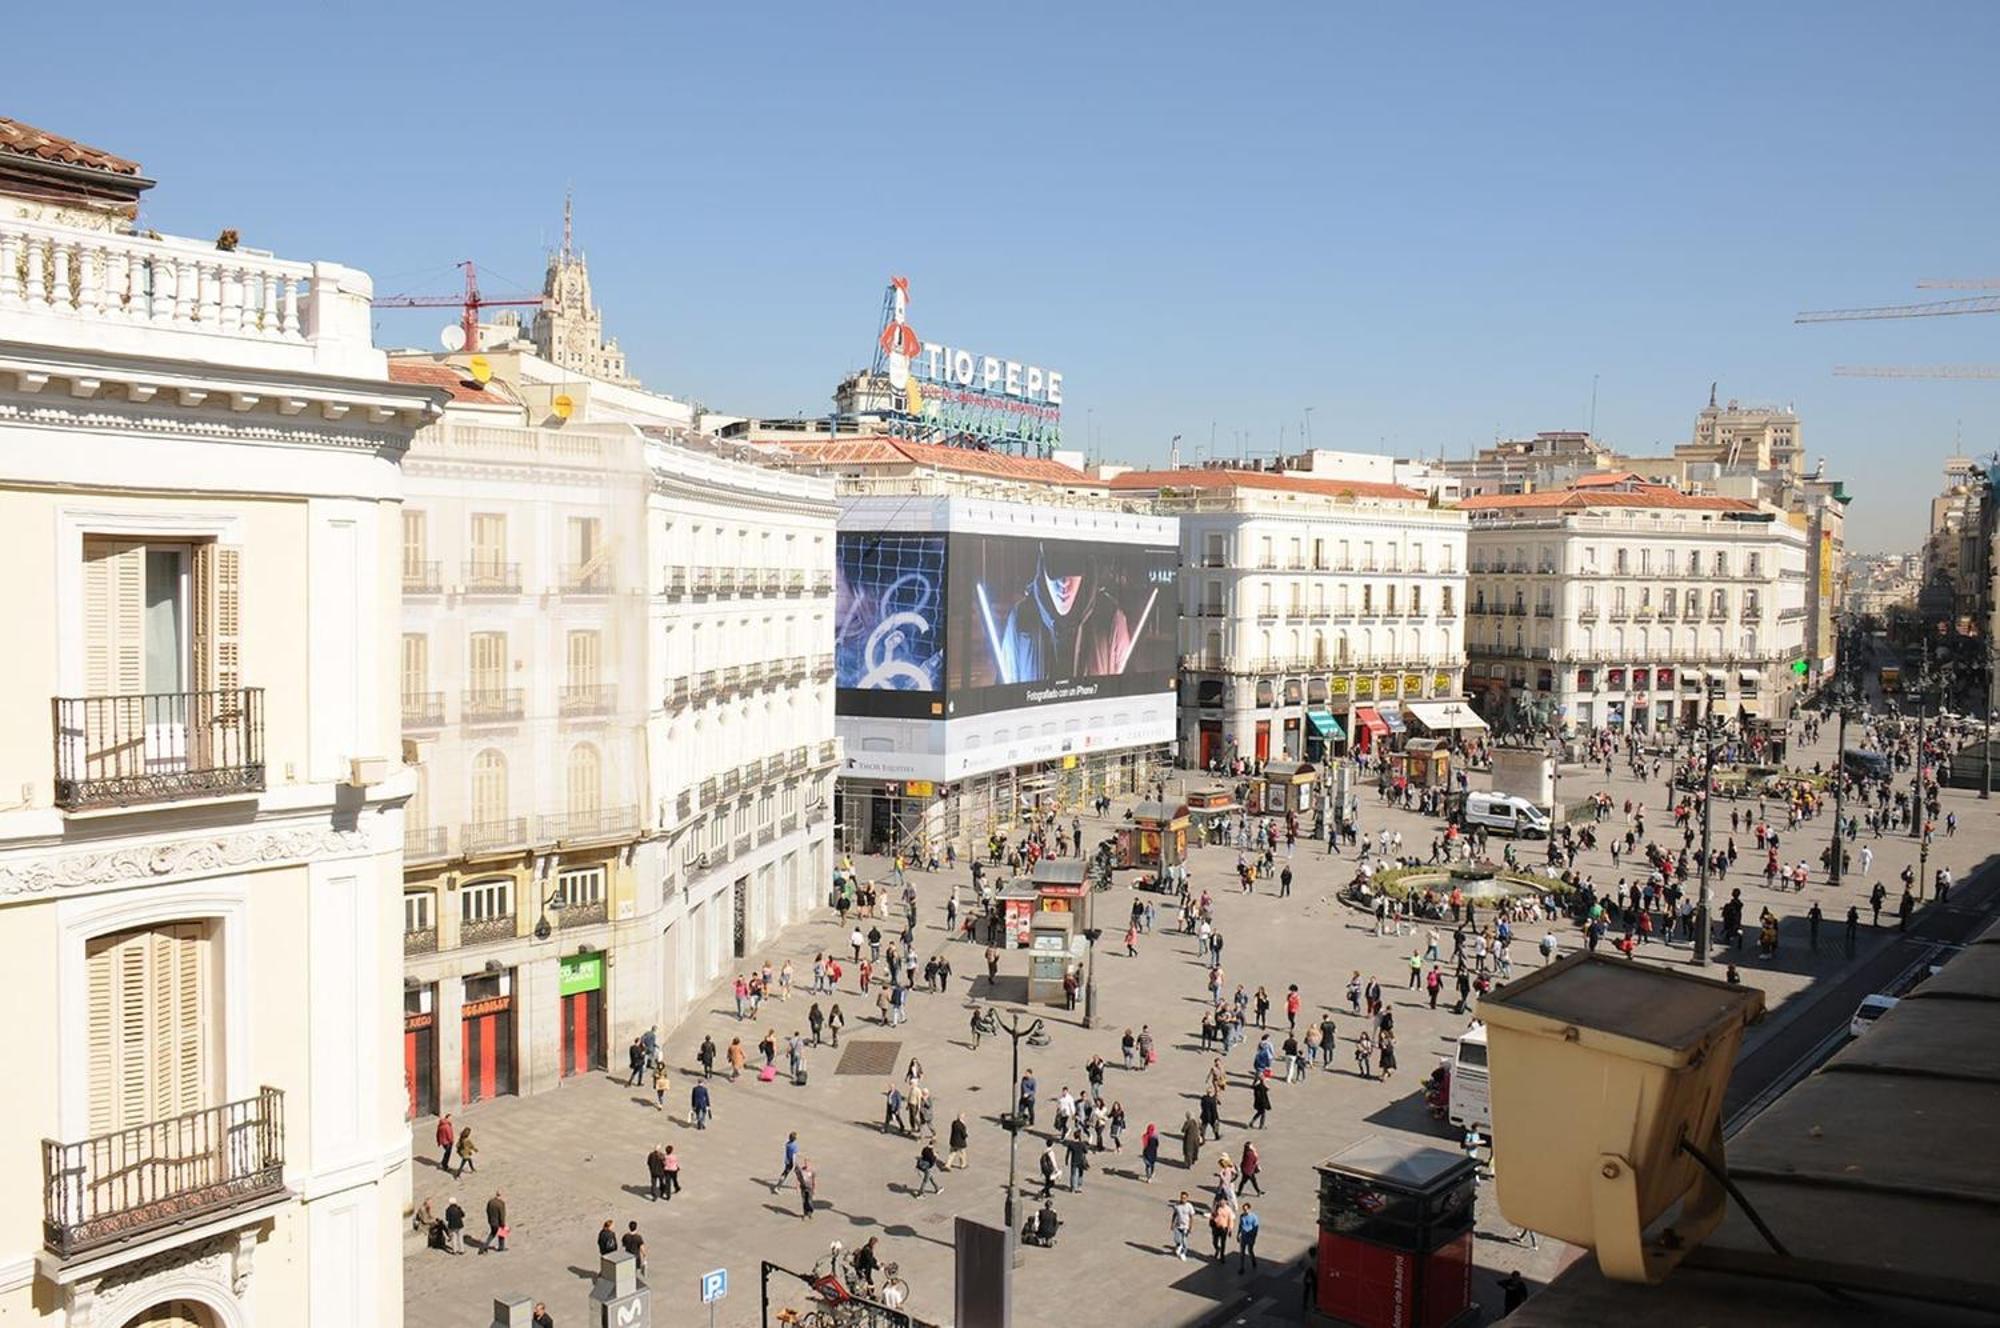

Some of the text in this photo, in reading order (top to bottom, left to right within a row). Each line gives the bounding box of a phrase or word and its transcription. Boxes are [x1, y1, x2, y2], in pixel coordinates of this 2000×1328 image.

[924, 342, 973, 384] TIO
[984, 356, 1062, 404] PEPE
[708, 1276, 722, 1299] P
[1394, 1255, 1405, 1289] Madrid
